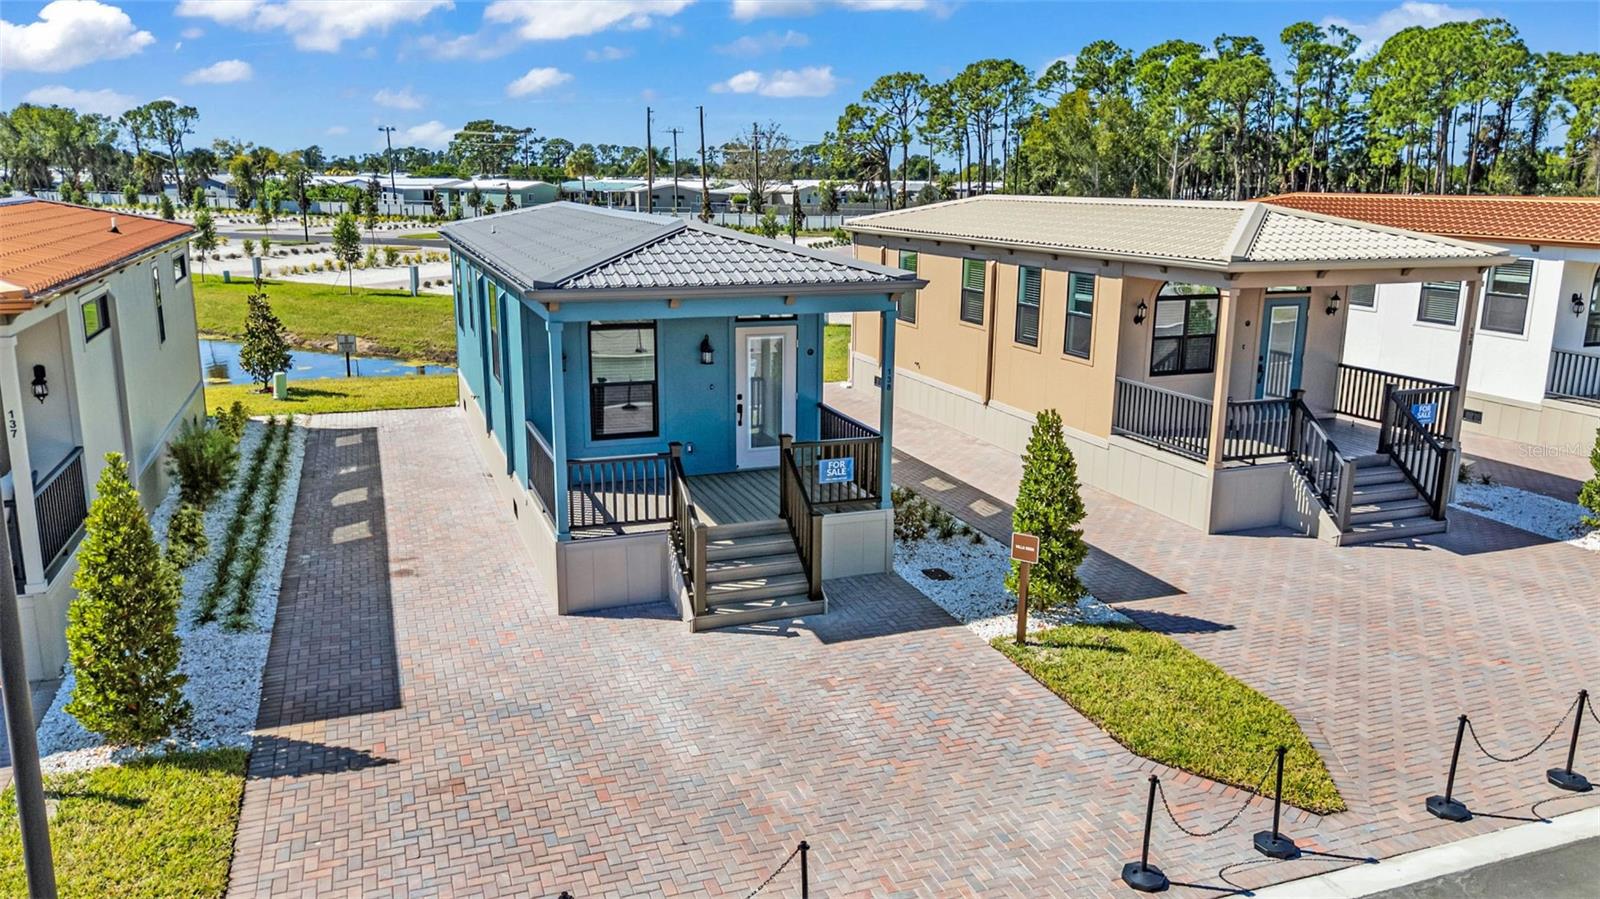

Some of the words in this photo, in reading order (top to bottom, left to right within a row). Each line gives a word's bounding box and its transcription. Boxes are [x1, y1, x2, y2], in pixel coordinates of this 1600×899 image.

[1419, 404, 1431, 412] FOR
[1417, 410, 1431, 419] SALE
[8, 409, 17, 438] 137
[828, 460, 846, 469] FOR
[826, 468, 847, 477] SALE
